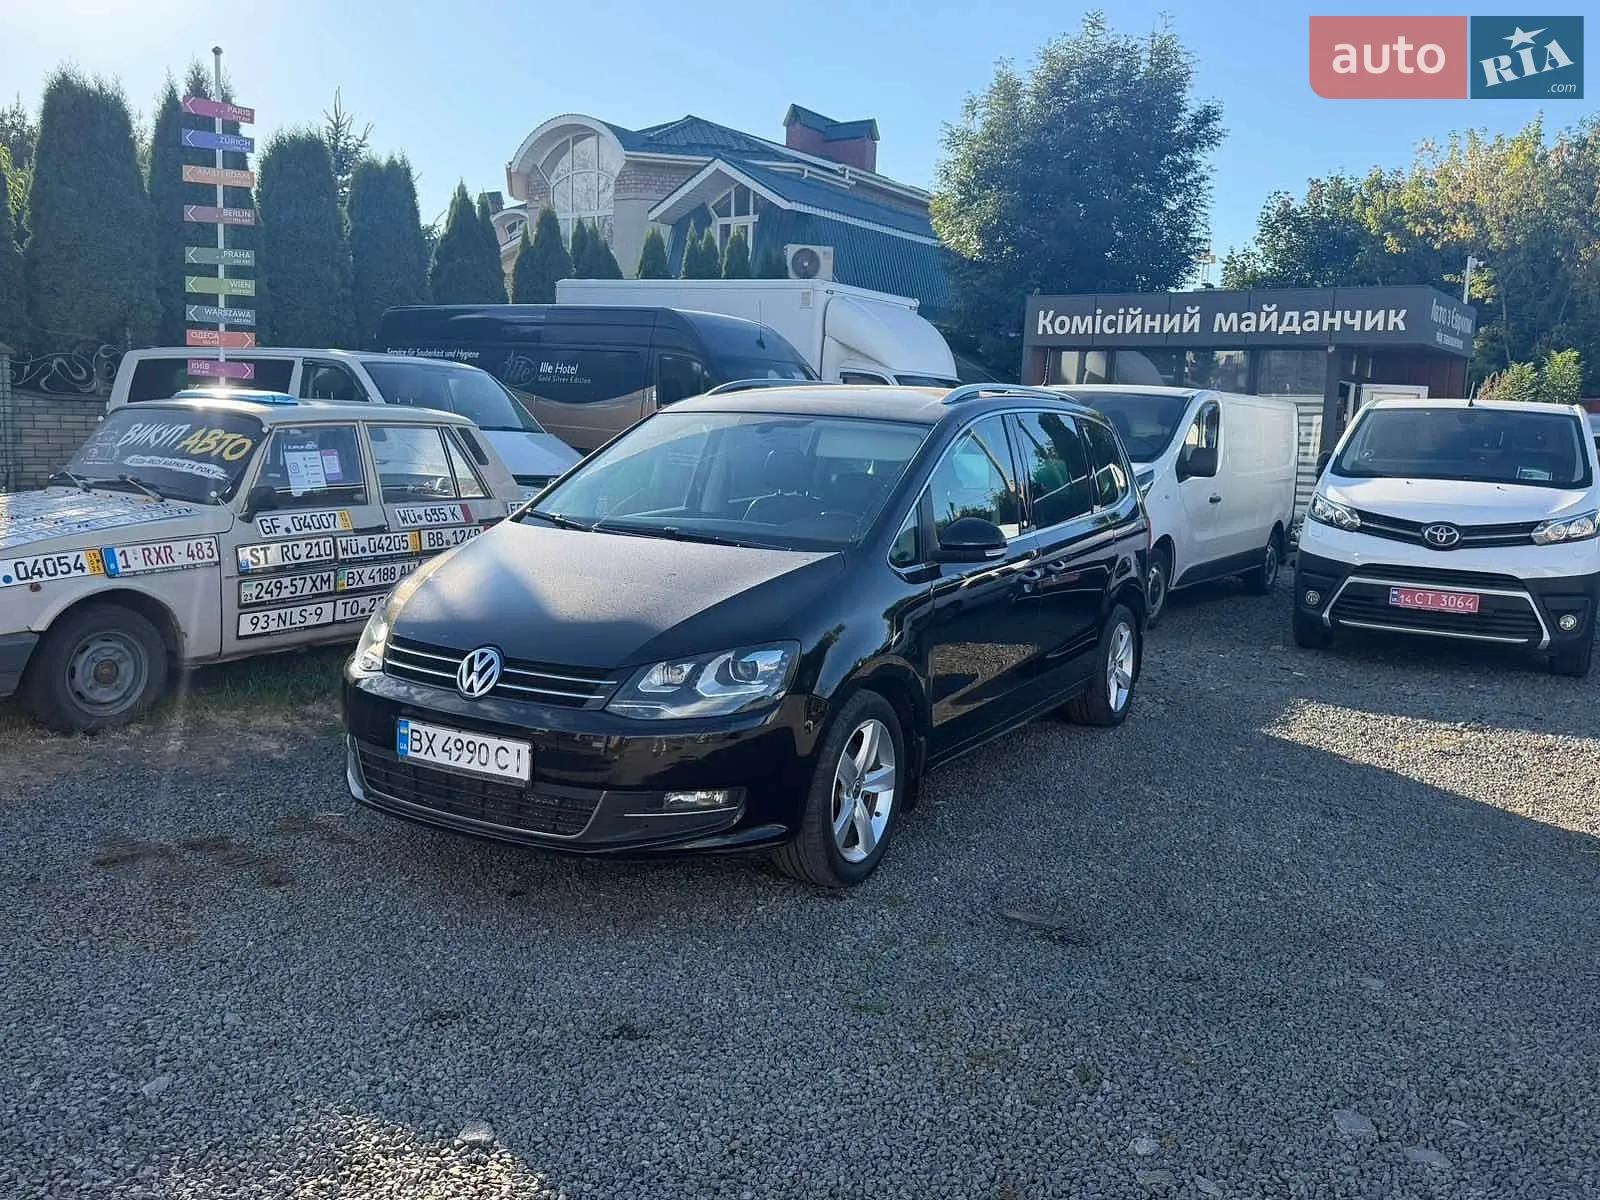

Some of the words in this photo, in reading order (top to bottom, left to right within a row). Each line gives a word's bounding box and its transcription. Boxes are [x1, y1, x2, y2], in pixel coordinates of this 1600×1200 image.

[222, 208, 251, 217] BERLIN
[223, 250, 251, 258] PRAHA
[230, 280, 251, 288] WIEN
[204, 308, 251, 318] WARSZAWA
[1037, 305, 1200, 335] Комісійний
[1213, 304, 1407, 335] майданчик
[555, 361, 579, 375] Hotel
[116, 423, 191, 449] ВИКУП
[175, 425, 253, 461] АВТО
[449, 506, 460, 521] K
[259, 517, 281, 535] GF
[291, 512, 337, 532] 04007
[367, 535, 409, 553] 04205
[427, 531, 445, 548] BB
[249, 546, 270, 567] ST
[281, 543, 302, 563] RC
[305, 540, 332, 559] 210
[346, 570, 365, 587] BX
[368, 566, 397, 584] 4188
[341, 599, 360, 617] TO
[1400, 594, 1412, 604] 14
[1414, 592, 1435, 605] CT
[1440, 594, 1474, 609] 3064
[249, 606, 324, 631] 93-NLS-9
[409, 728, 437, 758] BX
[441, 736, 490, 767] 4990
[494, 745, 522, 773] CI
